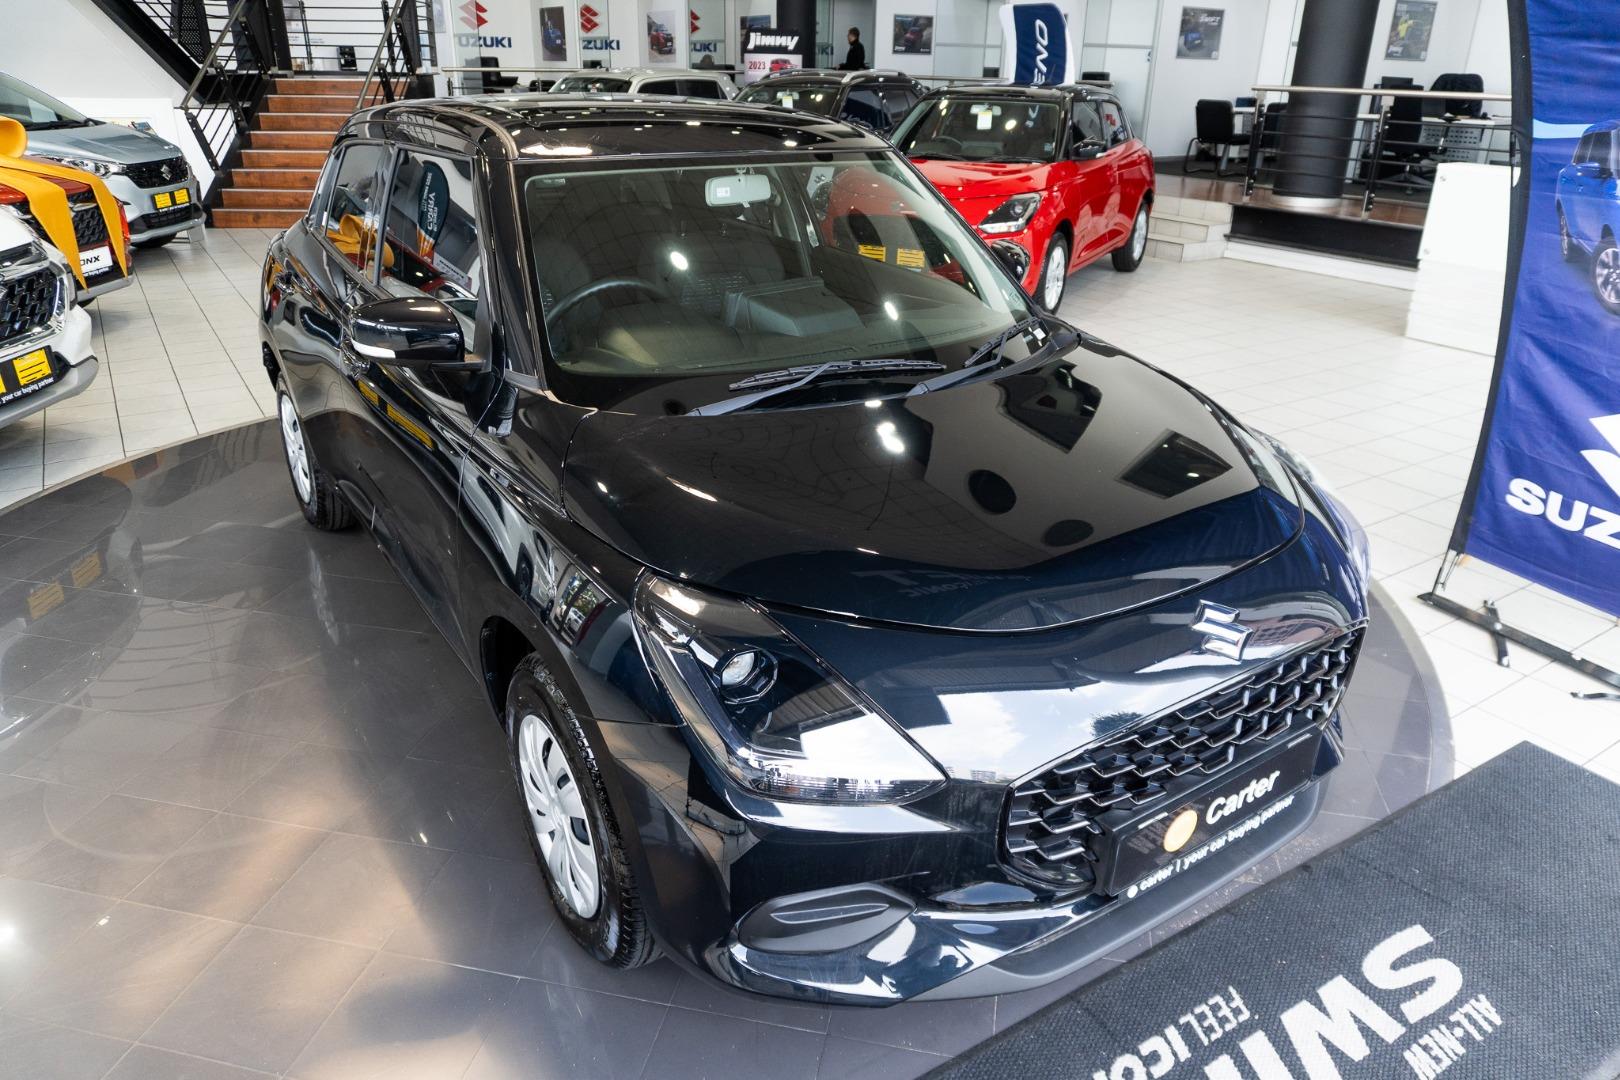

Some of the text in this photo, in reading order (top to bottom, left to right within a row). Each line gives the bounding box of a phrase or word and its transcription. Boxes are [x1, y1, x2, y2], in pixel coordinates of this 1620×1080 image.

[582, 39, 620, 50] ZUKI
[690, 42, 717, 52] UKI
[747, 33, 799, 51] Jimny
[748, 61, 766, 70] 2023
[1505, 478, 1620, 550] SUZ
[1205, 770, 1280, 825] Carter
[1139, 864, 1173, 891] carter
[1183, 846, 1210, 870] your
[1209, 835, 1228, 852] car
[1227, 815, 1261, 842] buying
[1260, 795, 1295, 825] partner
[1092, 985, 1250, 1080] FEEL ICO
